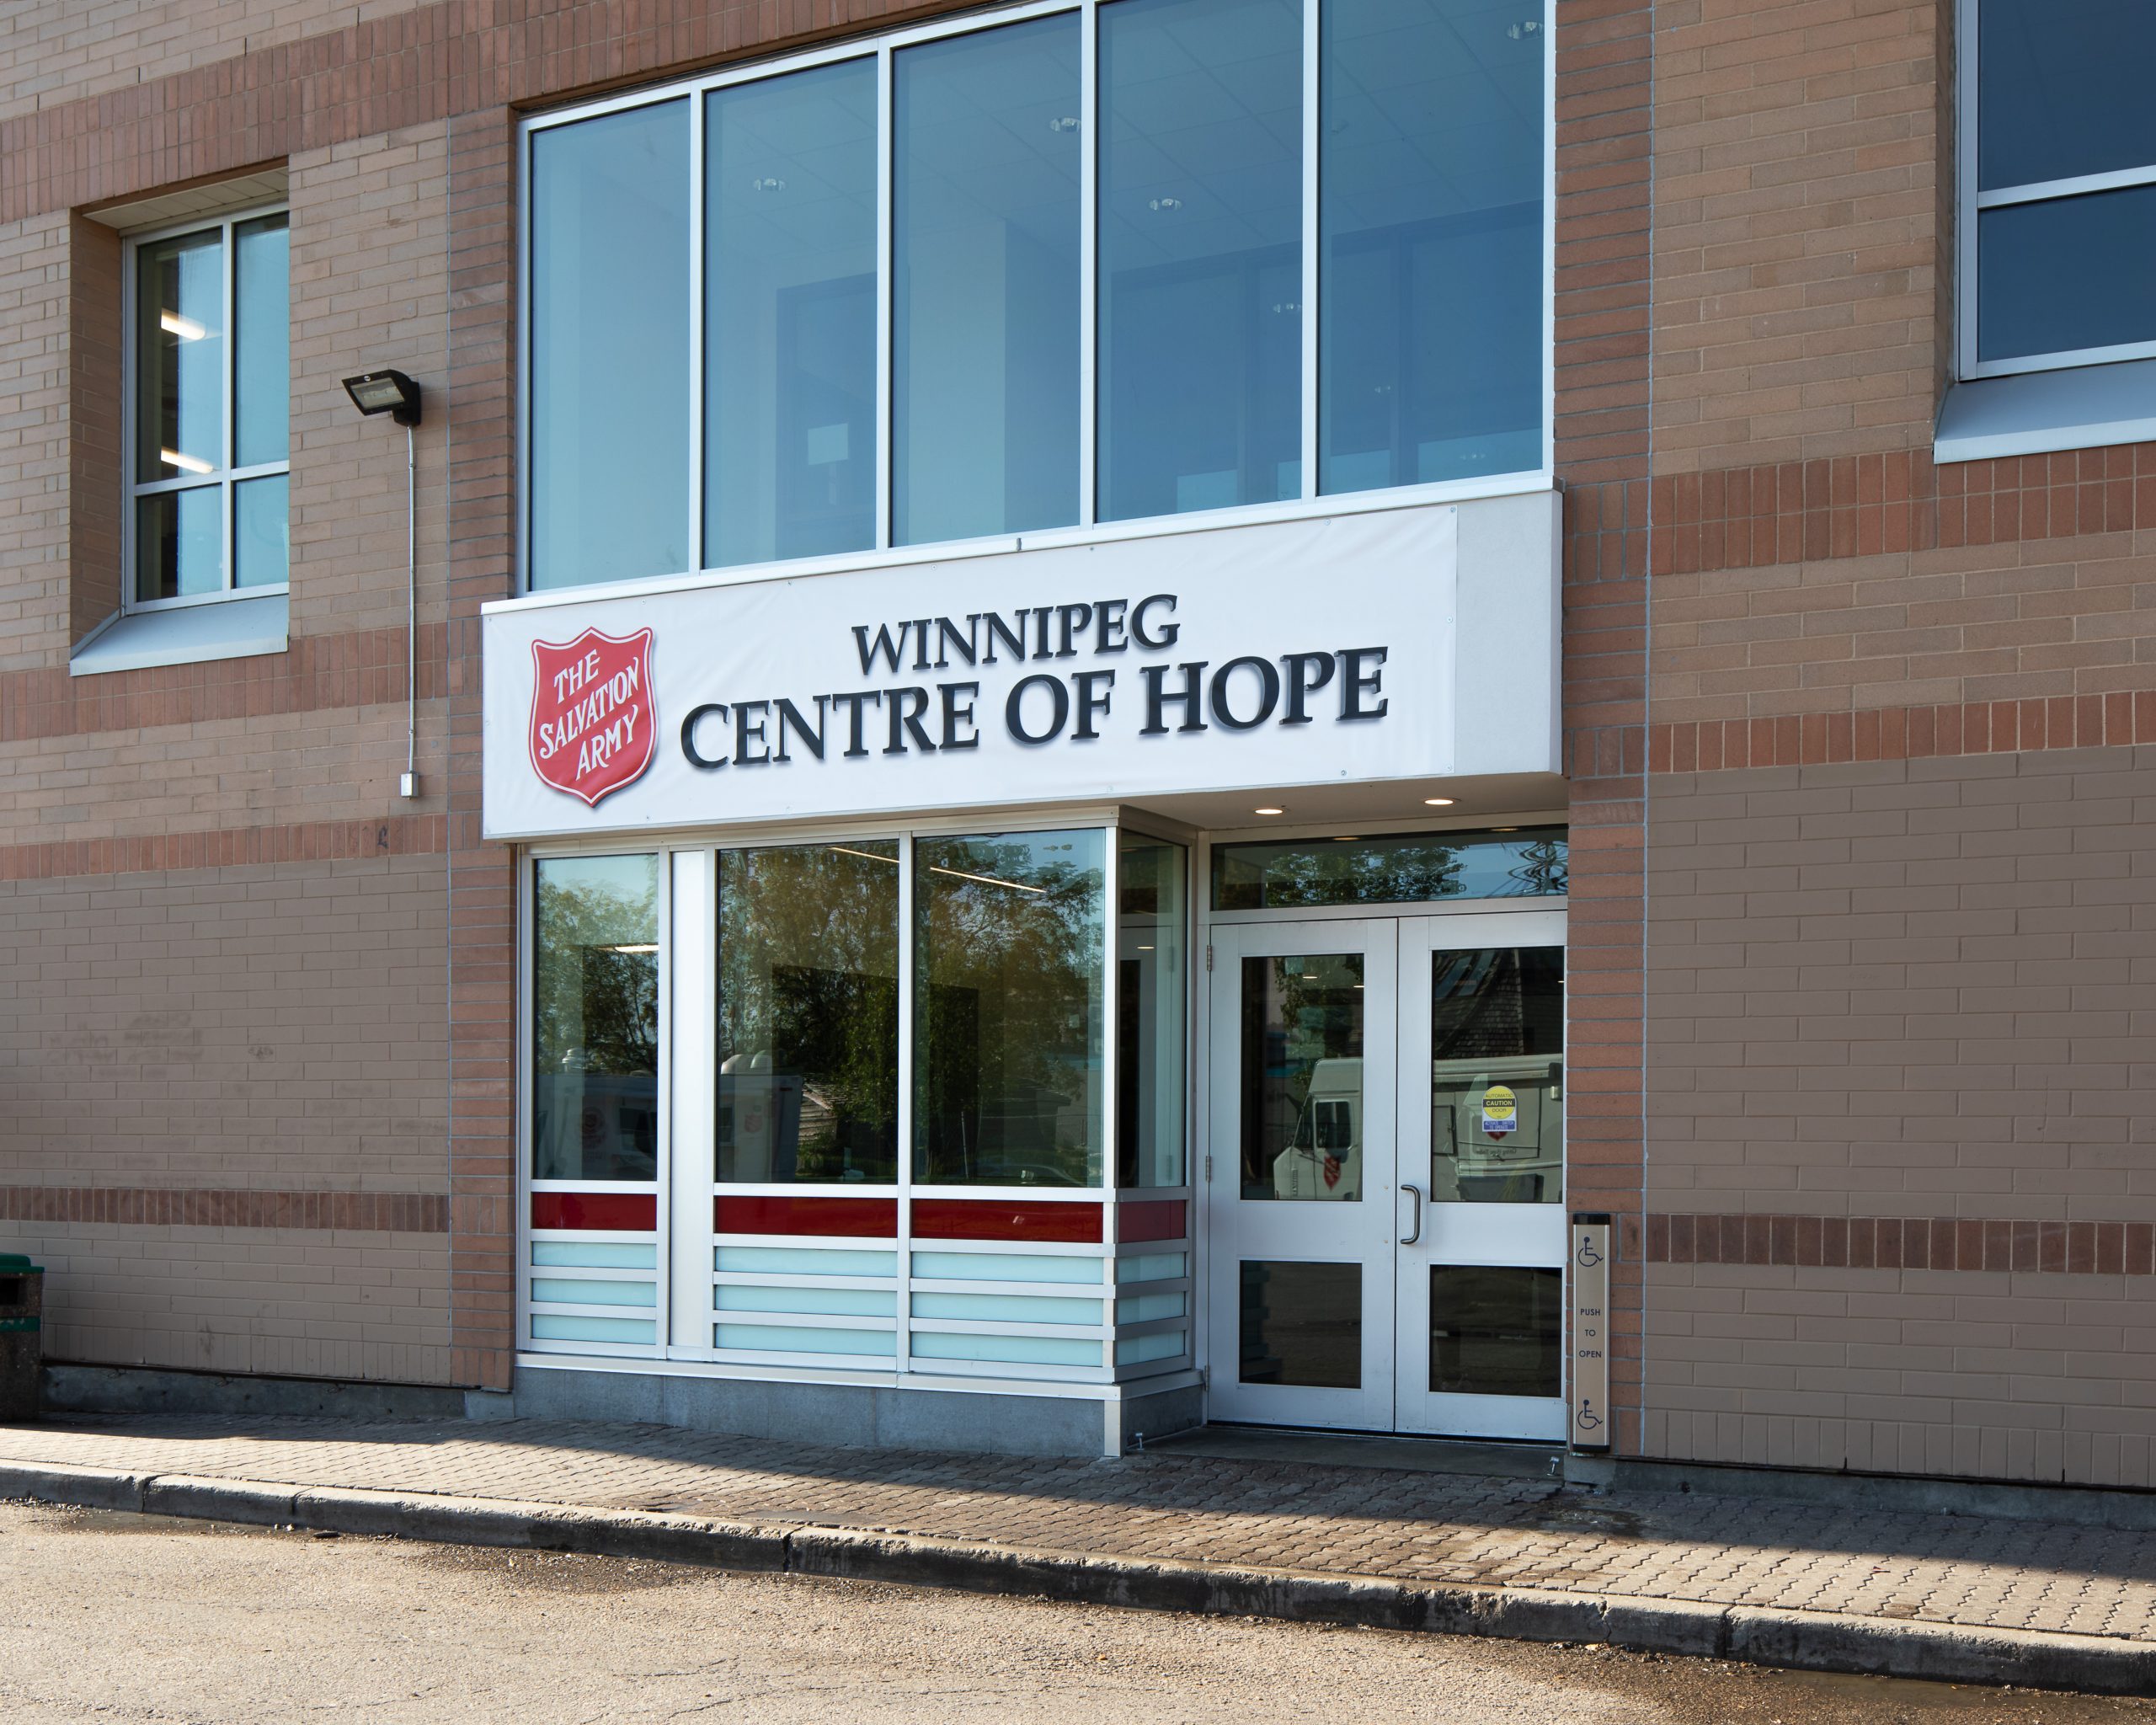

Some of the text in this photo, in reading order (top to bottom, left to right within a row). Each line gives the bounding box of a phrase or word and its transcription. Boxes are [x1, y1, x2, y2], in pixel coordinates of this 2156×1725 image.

[851, 594, 1181, 675] WINNIPEG
[539, 656, 640, 760] SALVATION
[553, 649, 601, 705] THE
[680, 646, 1389, 770] CENTRE OF HOPE
[574, 704, 640, 782] ARMY
[1580, 1308, 1601, 1316] PUSH
[1584, 1328, 1596, 1337] TO
[1578, 1349, 1602, 1358] OPEN
